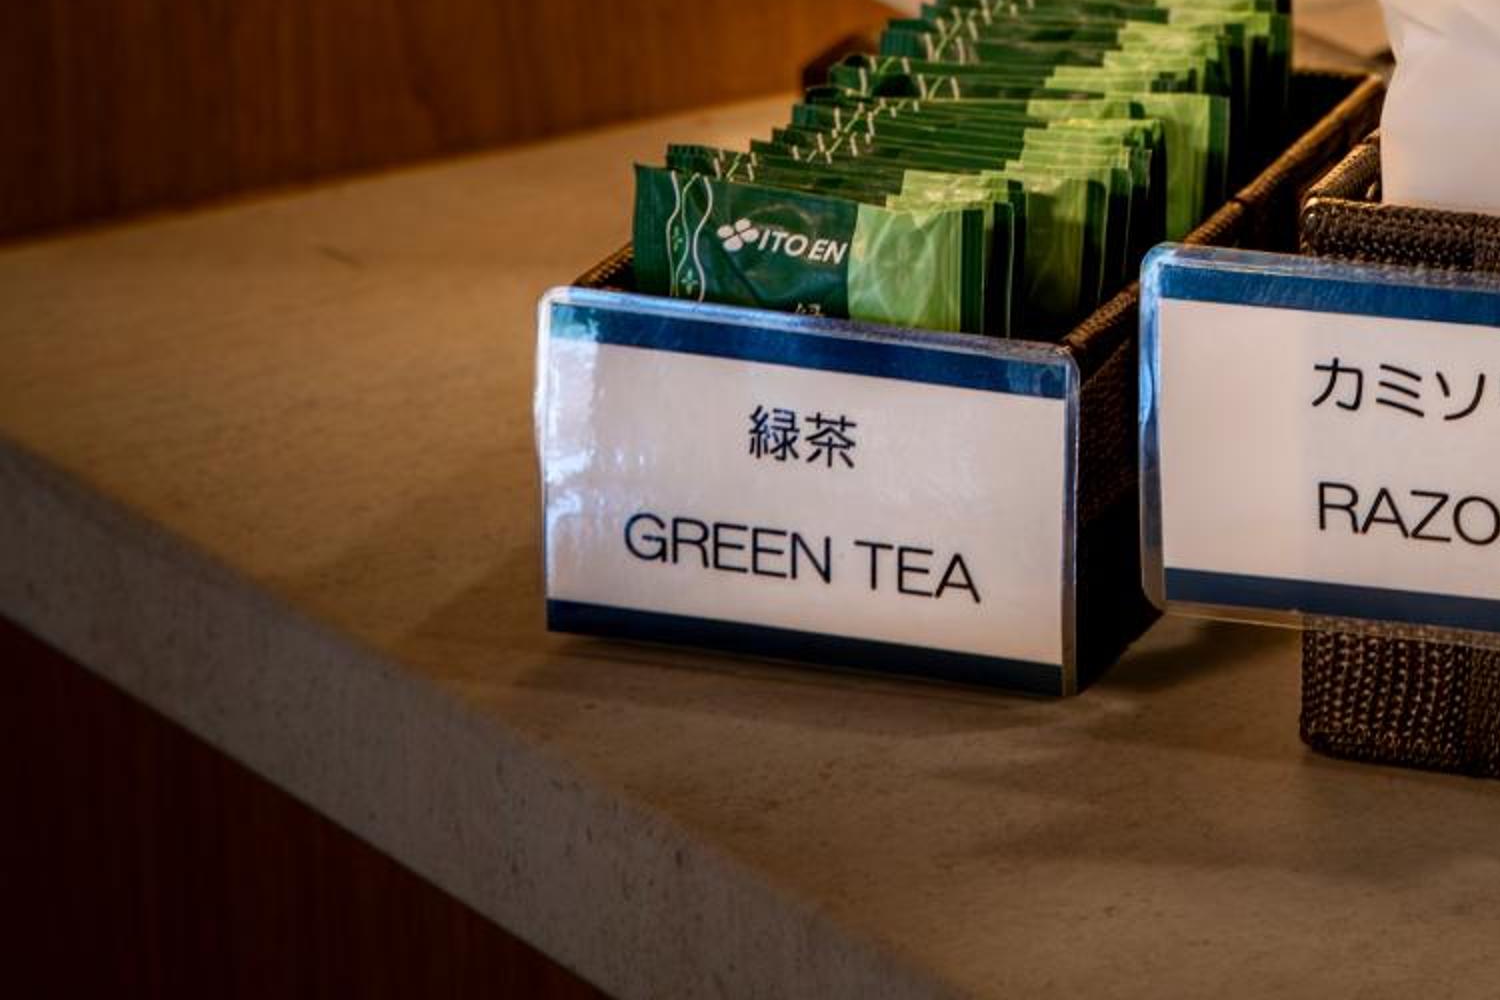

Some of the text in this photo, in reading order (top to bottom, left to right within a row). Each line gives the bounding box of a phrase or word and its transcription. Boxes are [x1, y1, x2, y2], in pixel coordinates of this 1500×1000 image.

[748, 404, 857, 469] 緑茶
[624, 512, 981, 604] GREEN TEA
